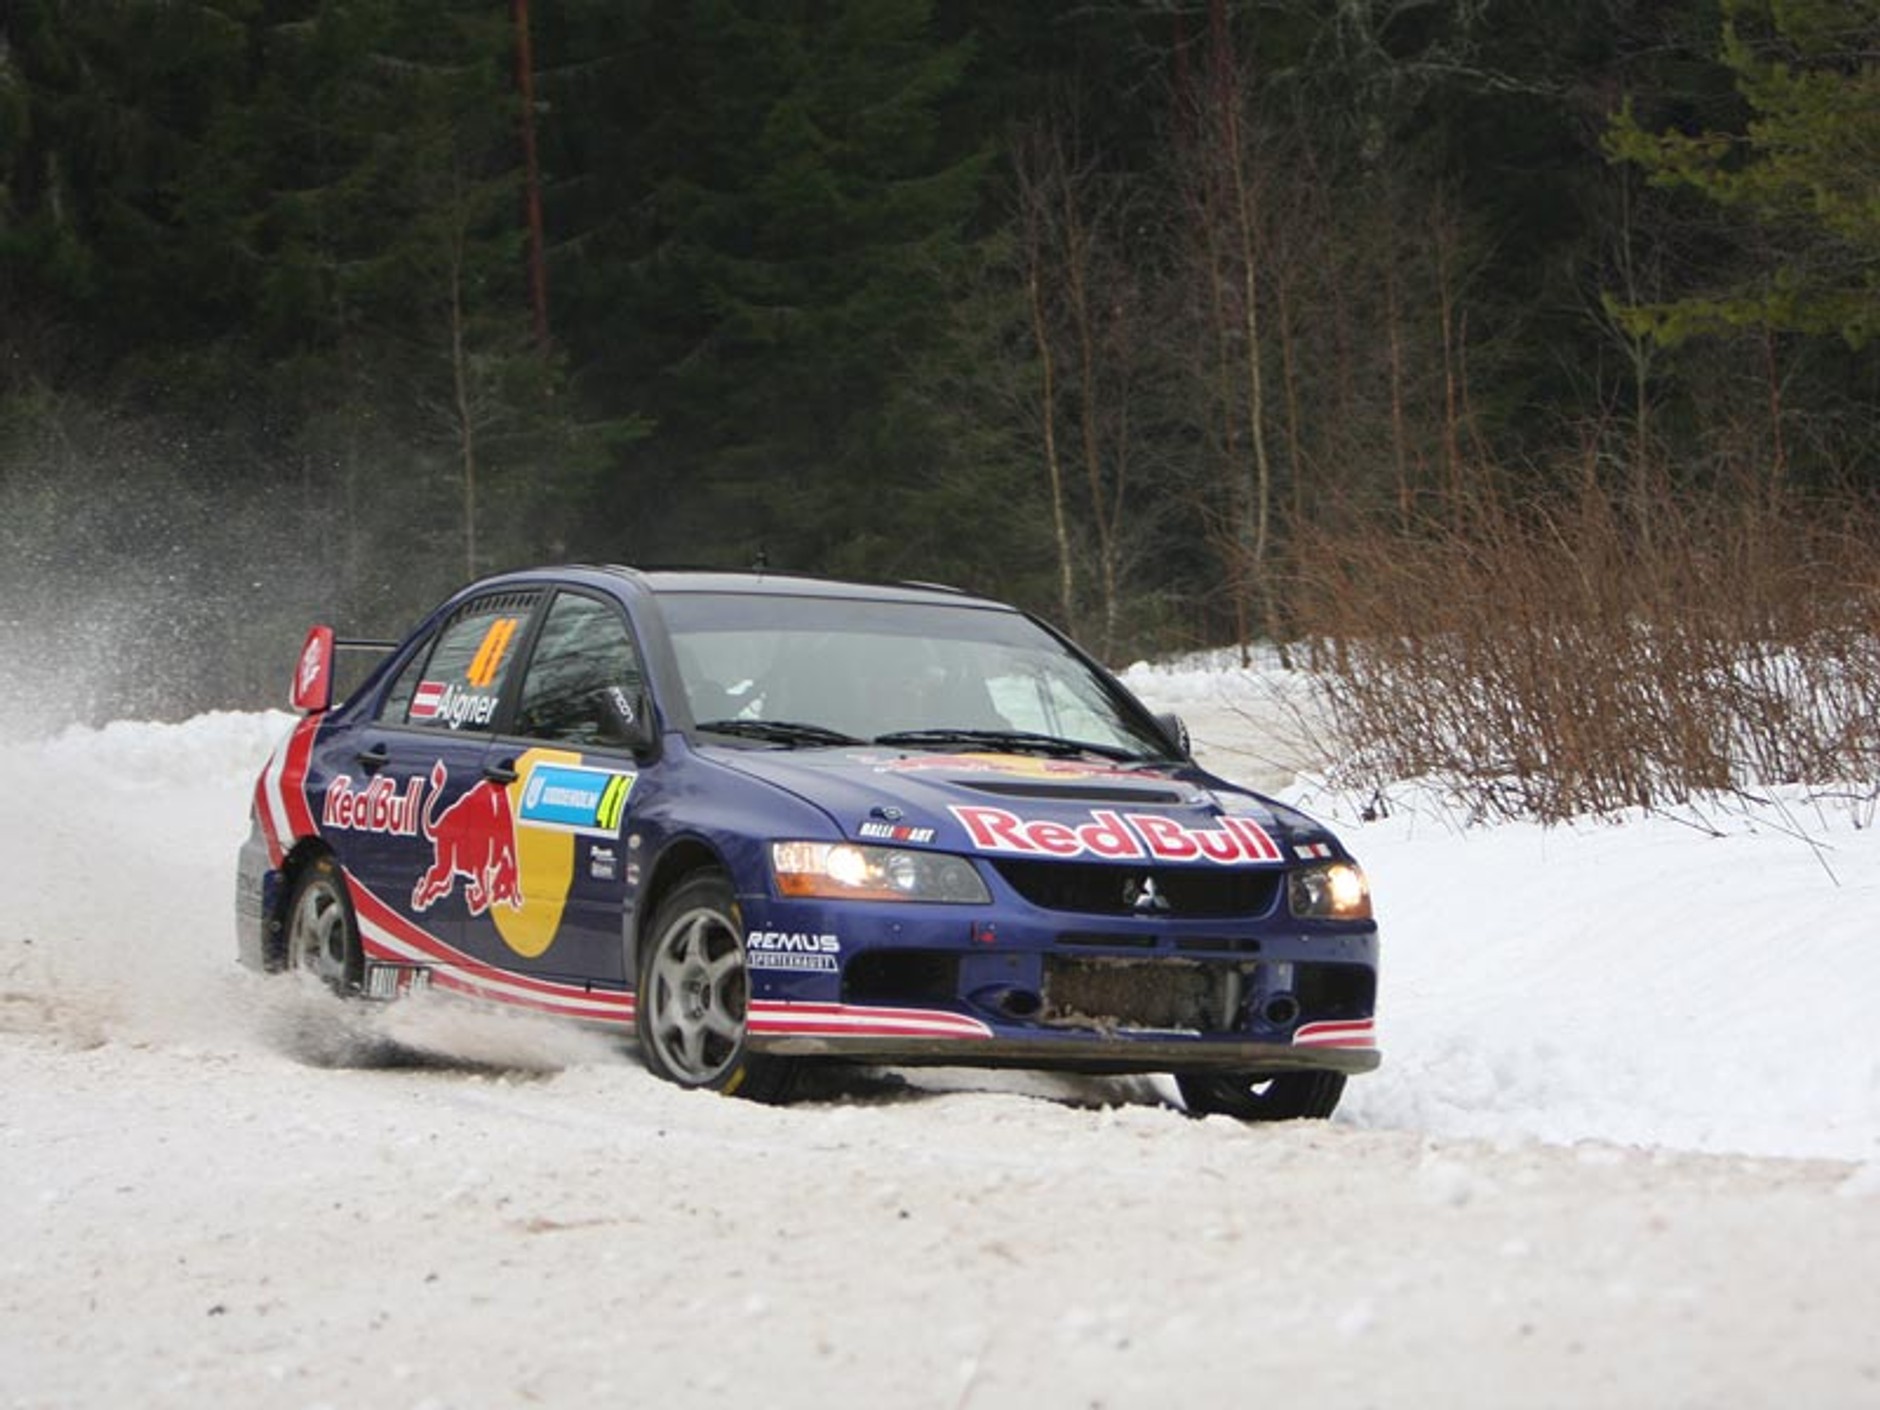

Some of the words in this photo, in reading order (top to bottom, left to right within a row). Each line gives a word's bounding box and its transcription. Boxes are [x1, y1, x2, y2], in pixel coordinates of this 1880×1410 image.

[436, 683, 499, 730] Aigner
[322, 774, 382, 831] Red
[370, 777, 426, 836] Bull
[946, 805, 1146, 859] Red
[1123, 813, 1285, 865] Bull
[746, 931, 840, 952] REMUS
